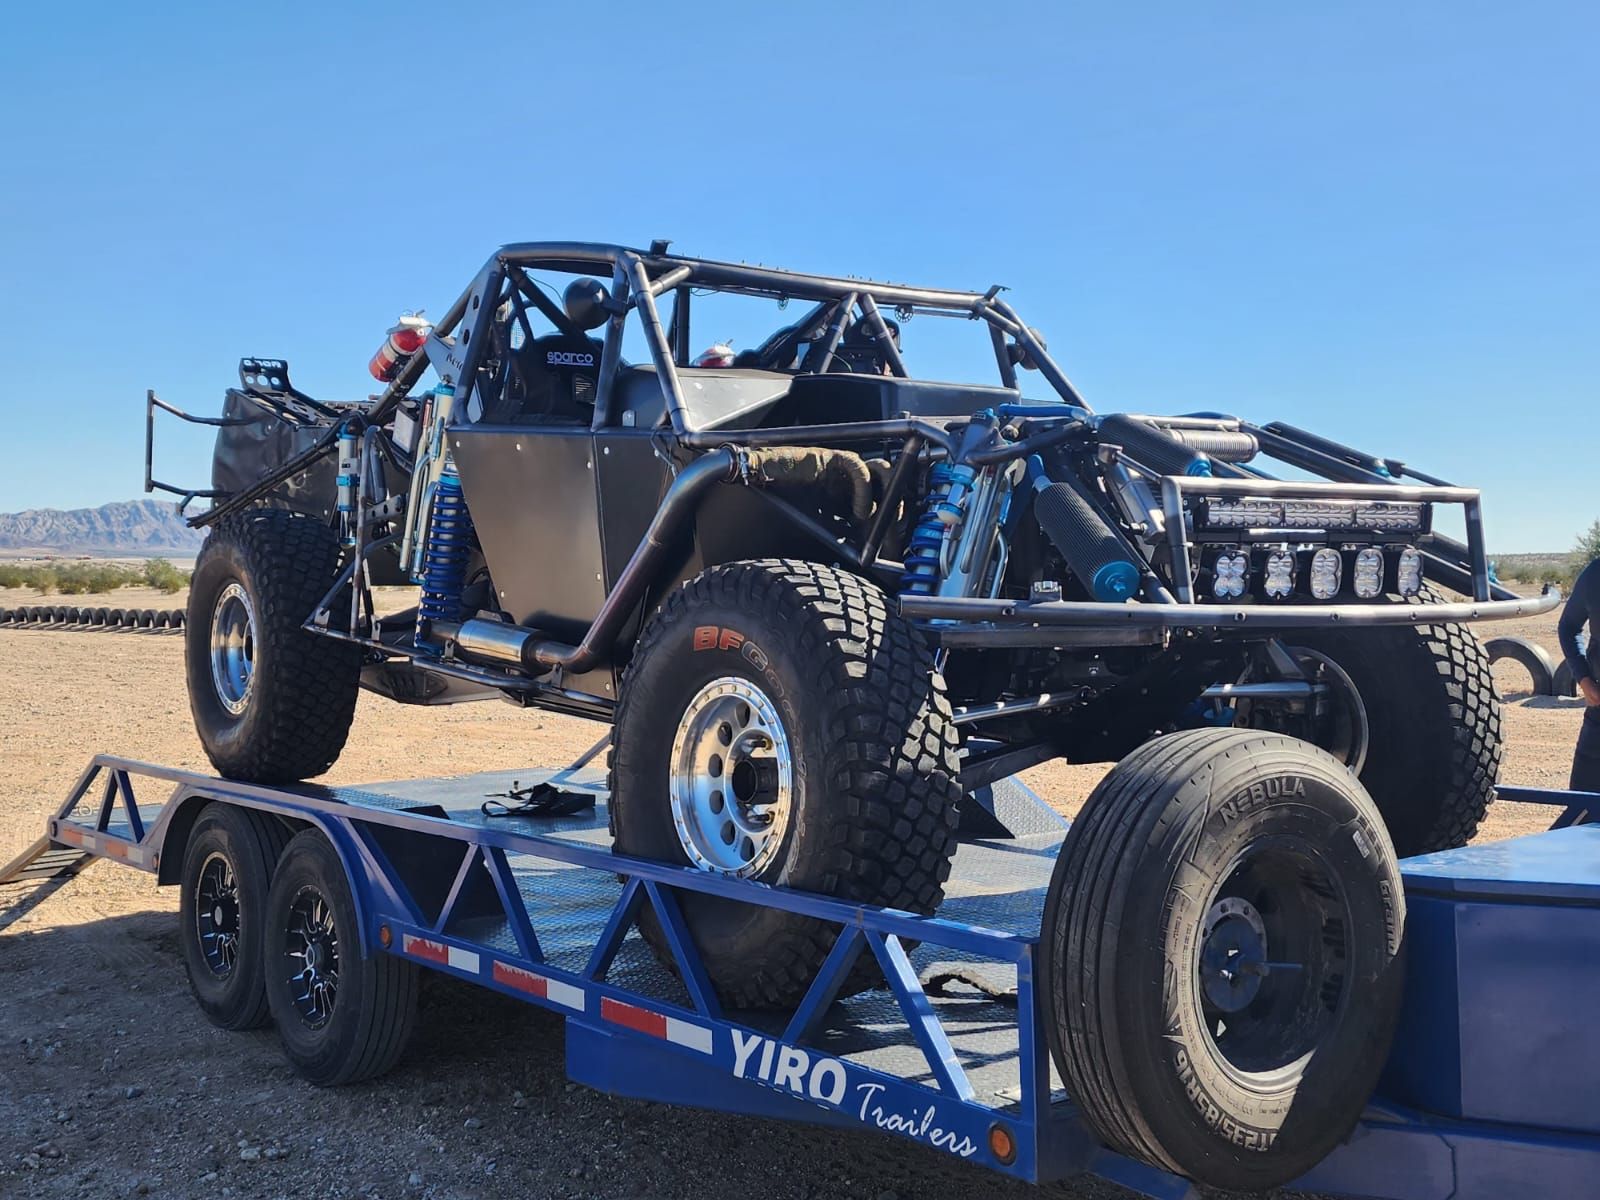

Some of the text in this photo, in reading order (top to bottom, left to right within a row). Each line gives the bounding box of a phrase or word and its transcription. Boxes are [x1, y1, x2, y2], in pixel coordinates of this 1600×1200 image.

[547, 351, 594, 366] sparco
[1218, 776, 1306, 827] NEBULA
[731, 1028, 977, 1157] YIRO Trailers
